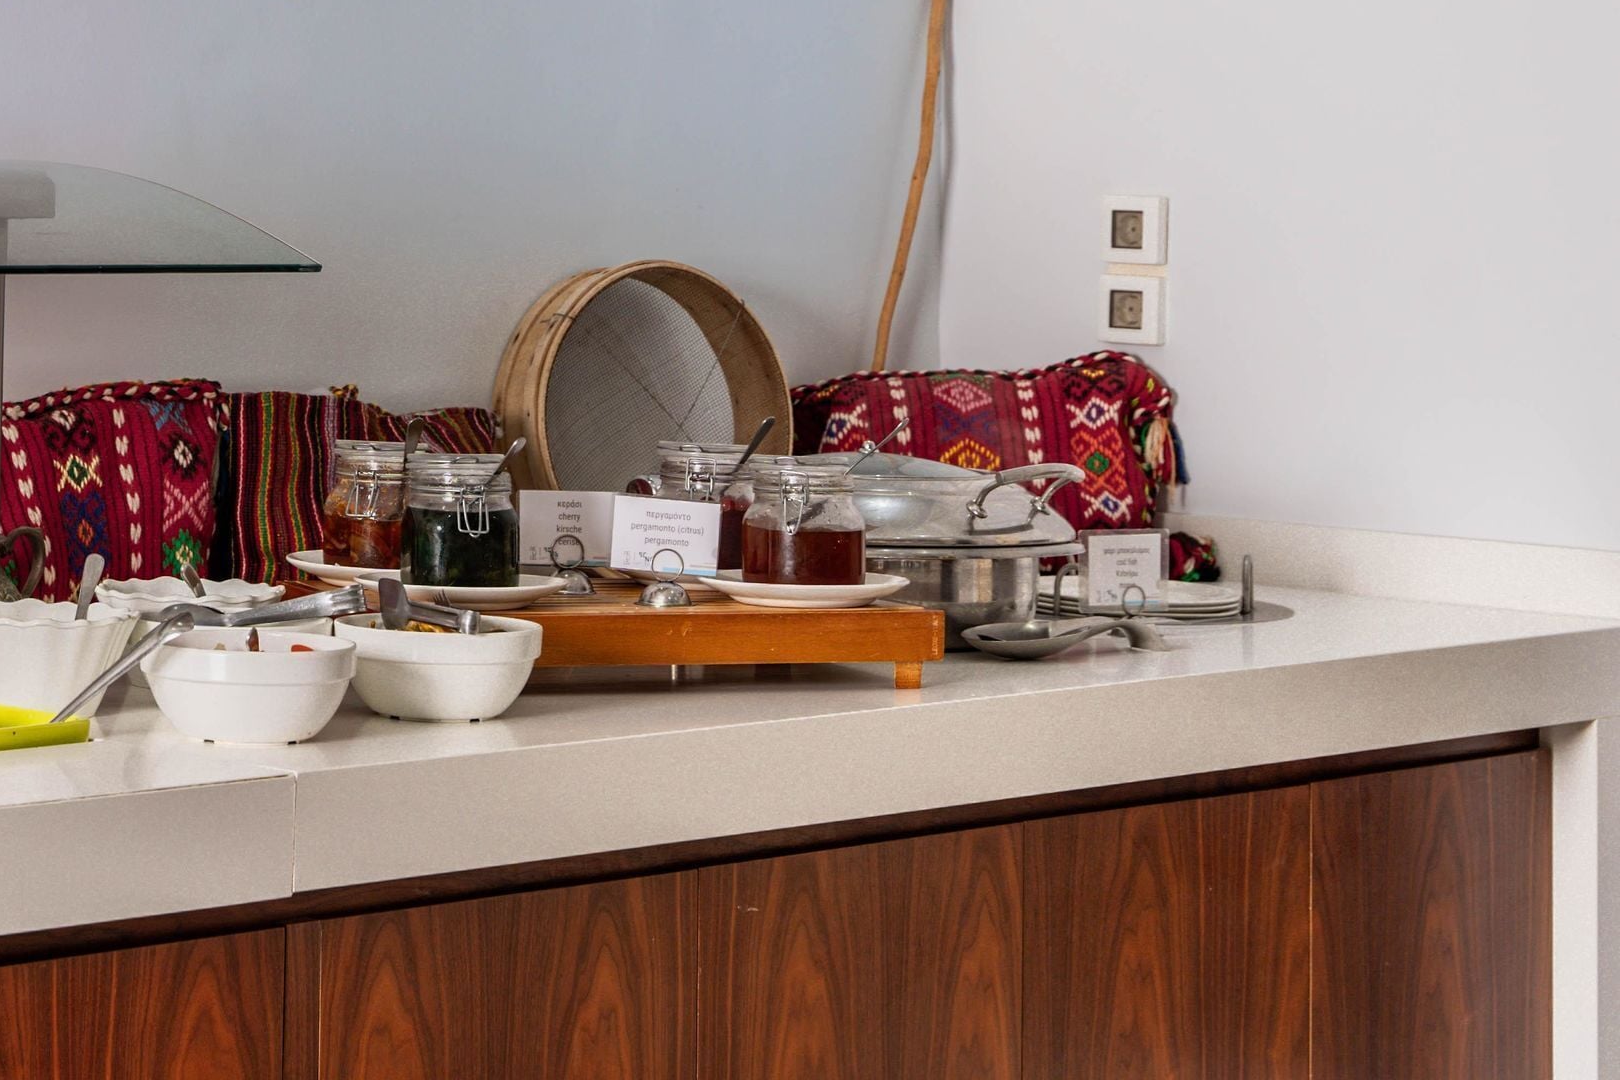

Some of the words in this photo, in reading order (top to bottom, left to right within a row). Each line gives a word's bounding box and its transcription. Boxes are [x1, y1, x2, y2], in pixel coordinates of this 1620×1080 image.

[558, 513, 581, 523] cherry
[556, 524, 583, 534] kirsche
[630, 523, 676, 533] pergamonto
[677, 525, 705, 536] (citrus)
[644, 537, 690, 547] pergamonto
